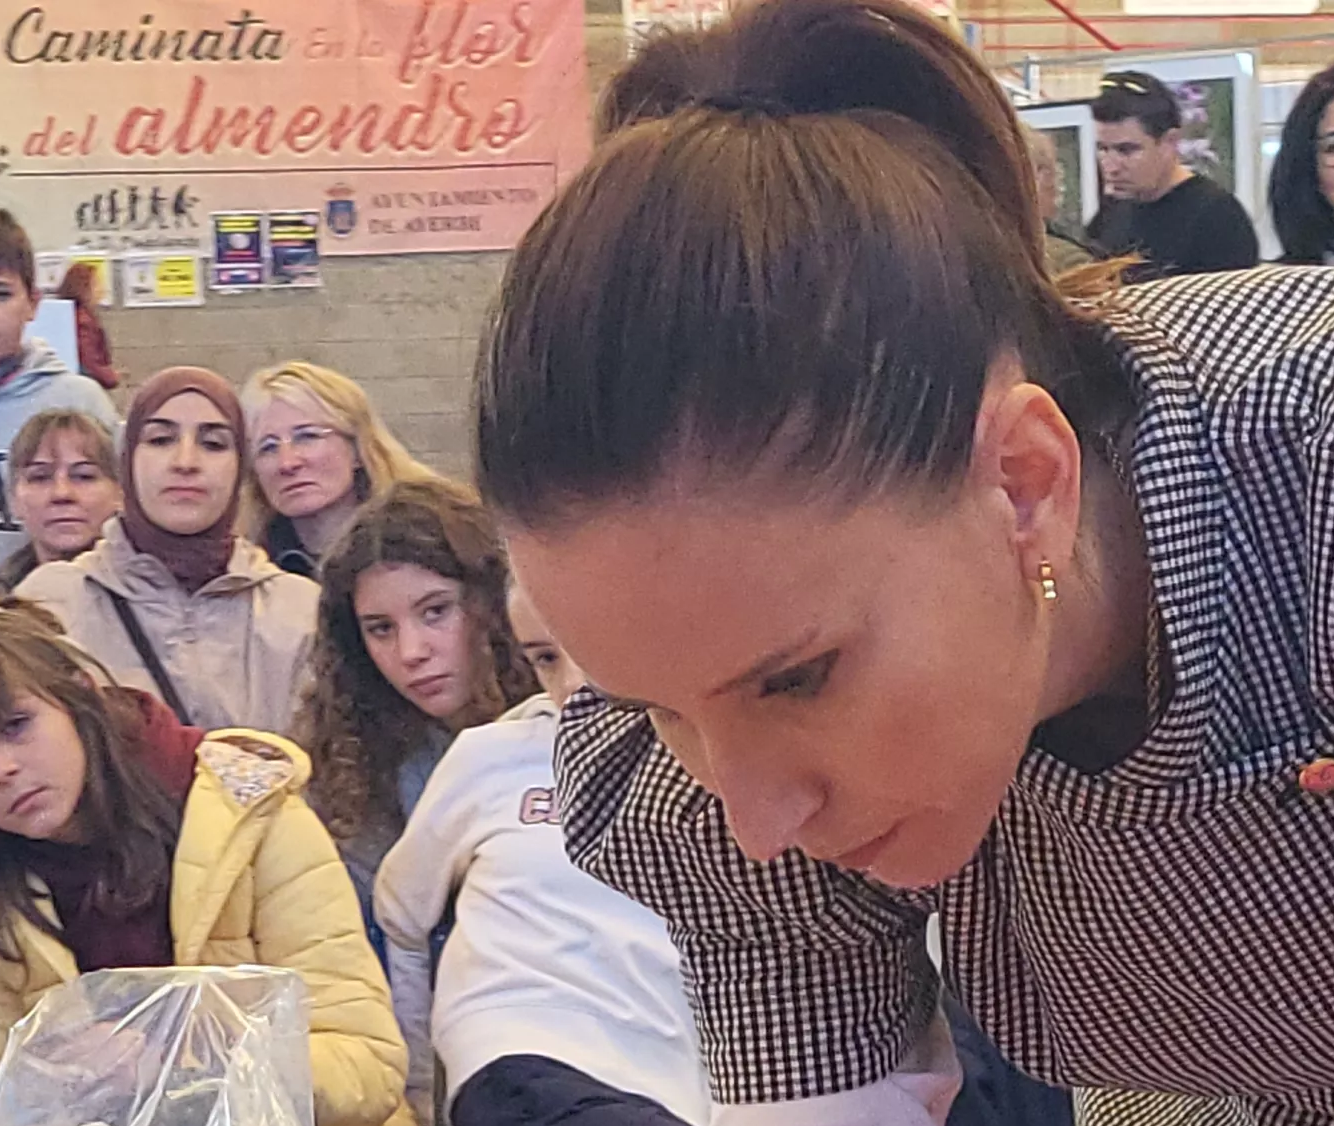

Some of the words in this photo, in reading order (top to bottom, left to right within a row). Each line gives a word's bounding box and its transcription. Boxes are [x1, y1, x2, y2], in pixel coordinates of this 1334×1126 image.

[4, 7, 285, 64] Caminata
[398, 0, 539, 85] flor
[21, 115, 97, 156] del
[114, 72, 529, 155] almendro
